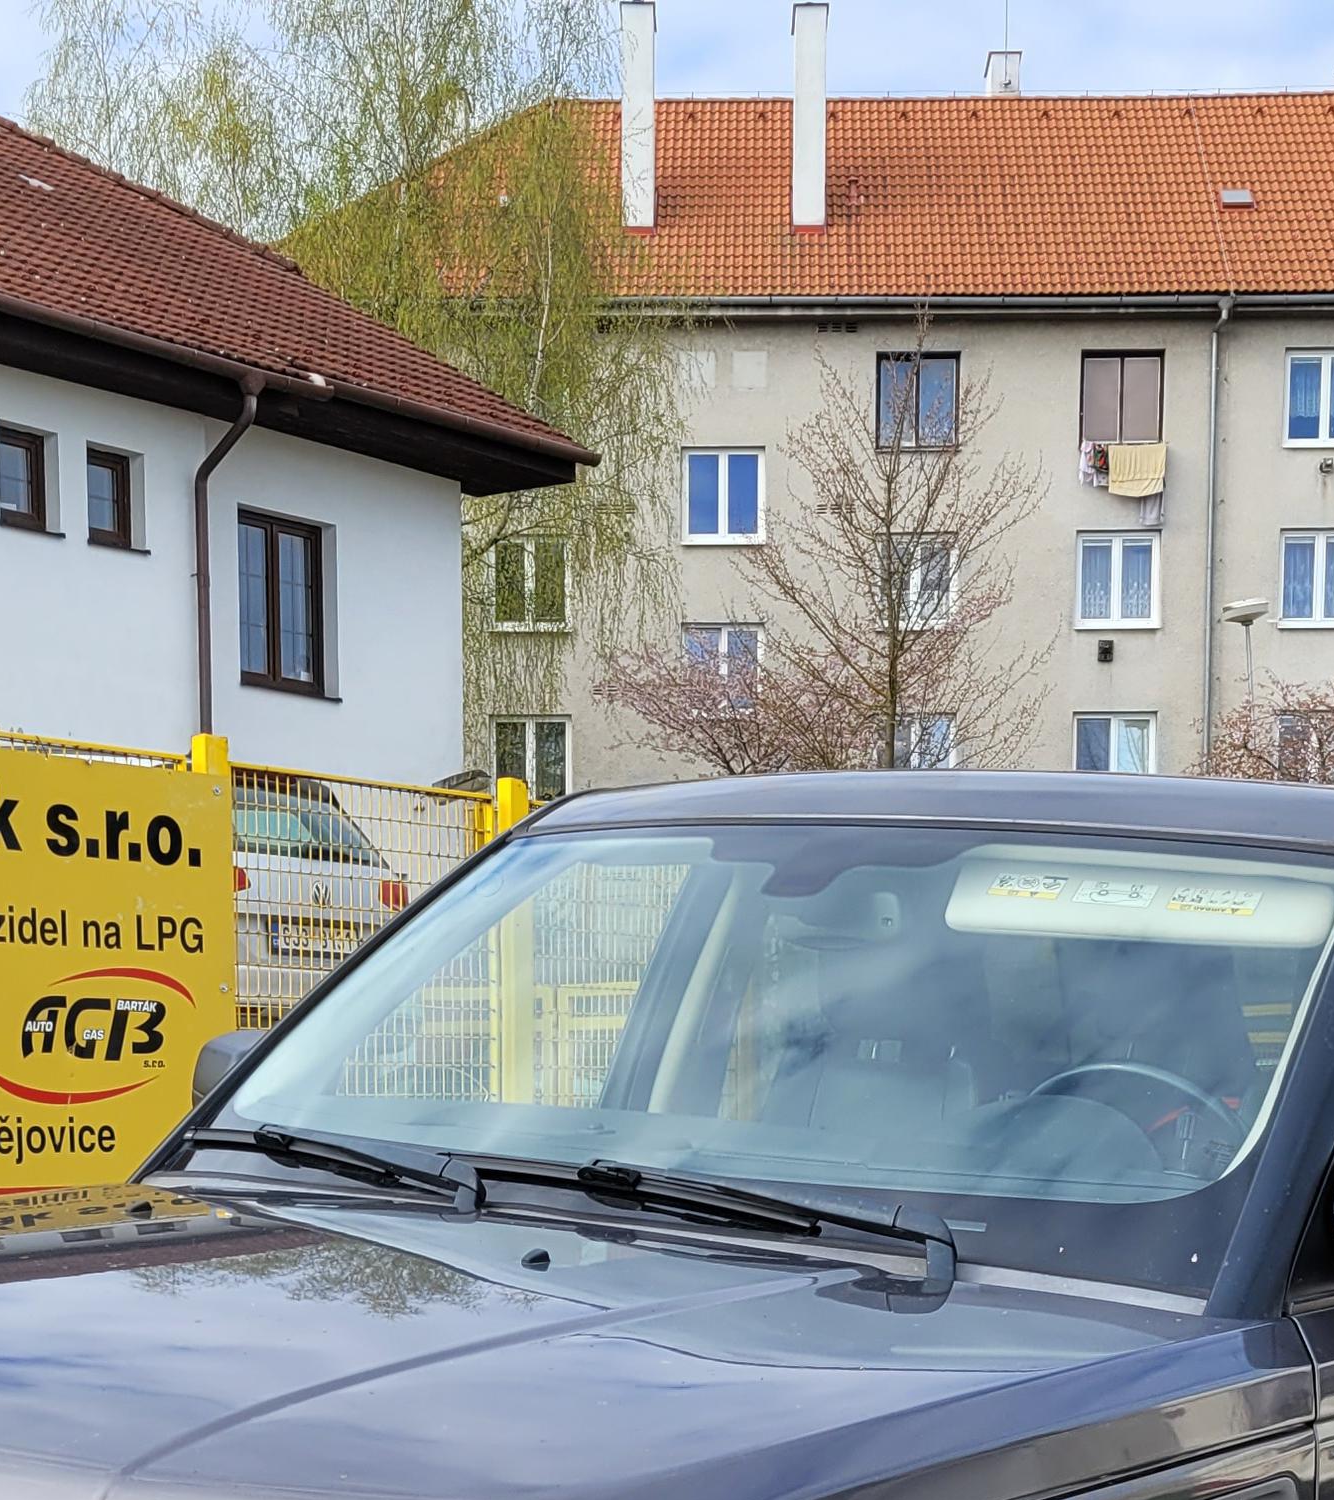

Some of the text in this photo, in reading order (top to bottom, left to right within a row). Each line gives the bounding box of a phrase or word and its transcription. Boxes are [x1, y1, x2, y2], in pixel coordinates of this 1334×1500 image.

[46, 803, 202, 868] s.r.o.
[83, 917, 122, 950] na
[136, 914, 204, 954] LPG
[117, 1000, 158, 1013] BARTÁK
[24, 1020, 54, 1033] AUTO
[83, 1029, 105, 1041] GAS
